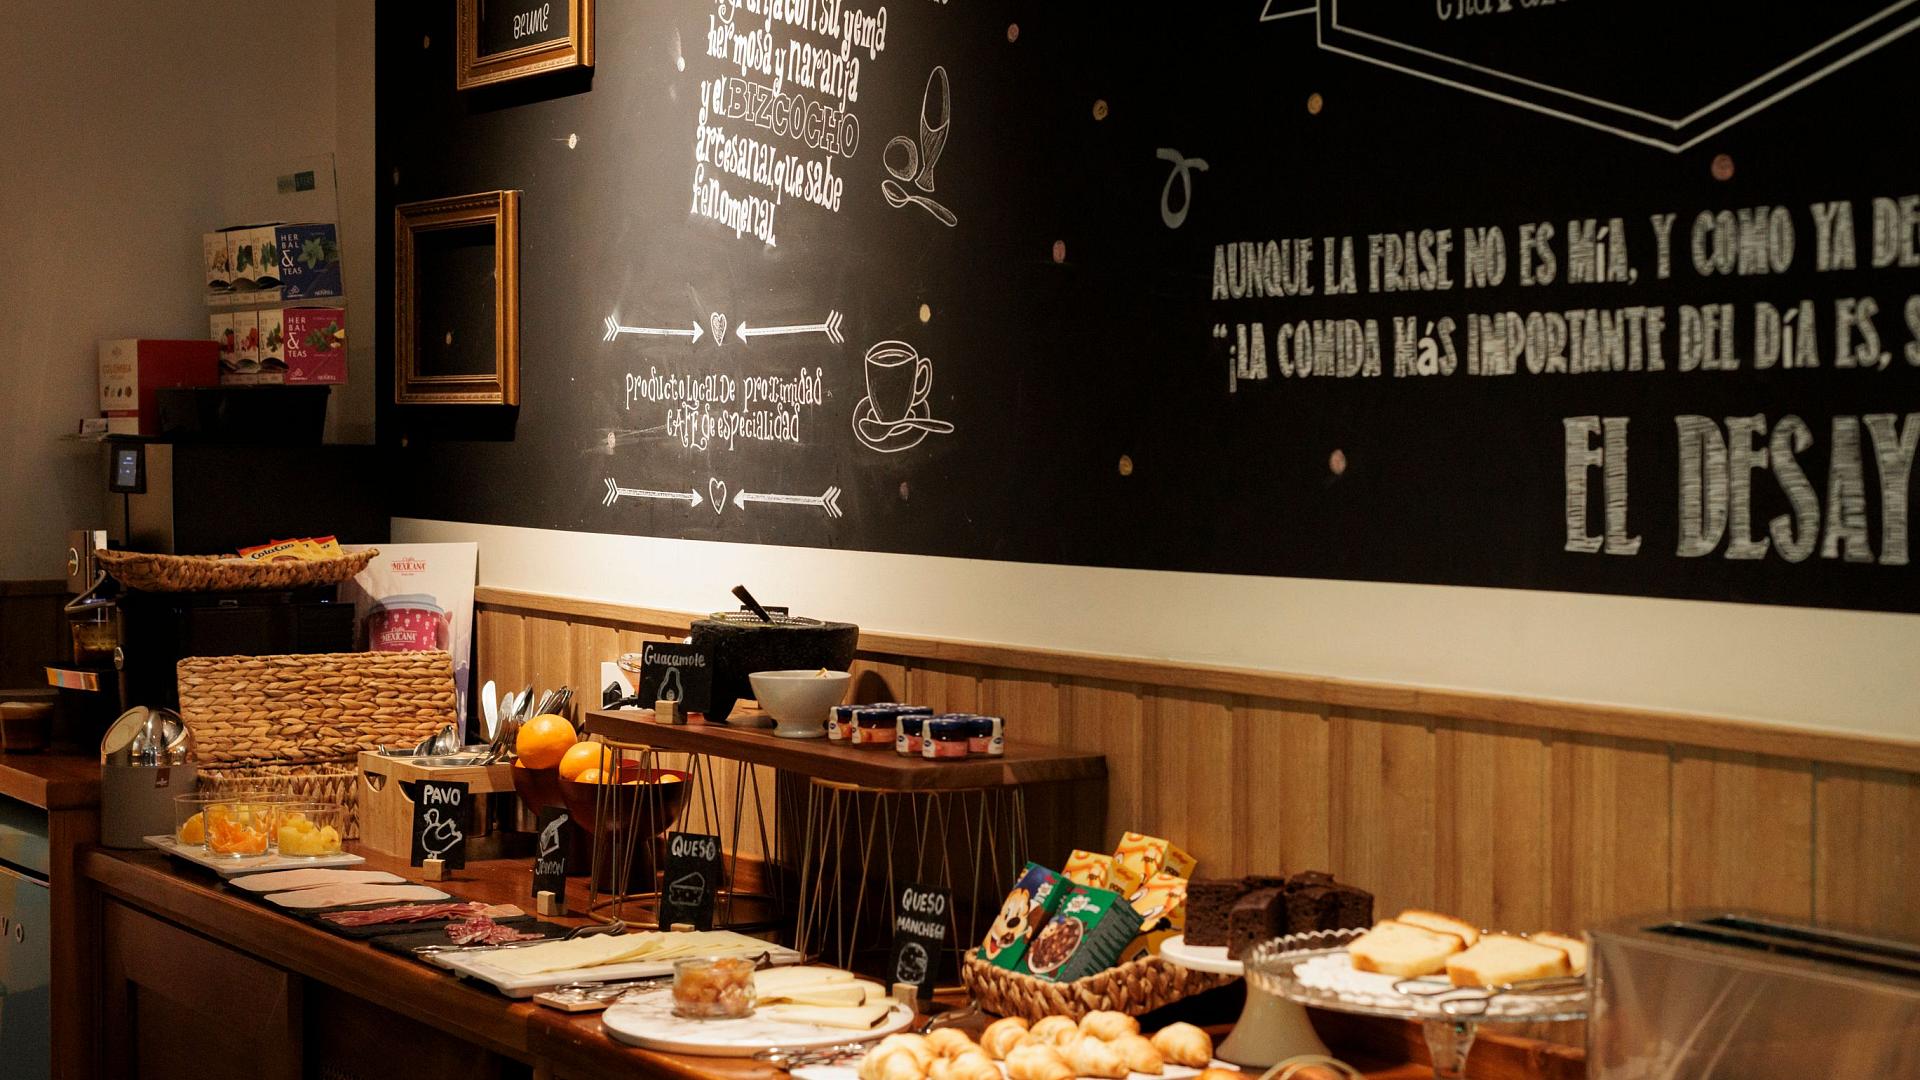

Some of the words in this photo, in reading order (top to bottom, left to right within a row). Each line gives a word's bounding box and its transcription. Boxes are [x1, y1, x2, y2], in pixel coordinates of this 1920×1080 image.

[842, 7, 888, 60] yema
[707, 15, 773, 76] hermosa
[773, 47, 787, 96] y
[788, 39, 861, 113] naranja
[699, 80, 713, 126] y
[728, 77, 860, 158] BIZCOCHO
[774, 155, 804, 205] que
[804, 156, 843, 213] sabe
[281, 233, 299, 242] HER
[281, 241, 300, 249] BAL
[281, 249, 295, 267] &
[1212, 237, 1315, 300] AUNQUE
[1323, 236, 1357, 296] LA
[1367, 228, 1454, 293] FRASE
[1464, 226, 1507, 288] NO
[1518, 221, 1557, 286] ES
[1650, 213, 1677, 279] Y
[1691, 205, 1795, 276] COMO
[1809, 200, 1857, 272] YA
[282, 267, 302, 276] TEAS
[287, 316, 306, 325] HER
[288, 324, 307, 332] BAL
[287, 332, 300, 350] &
[1277, 319, 1382, 378] COMIDA
[1467, 306, 1666, 376] IMPORTANTE
[1678, 303, 1740, 372] DEL
[1834, 296, 1893, 371] ES,
[287, 350, 308, 358] TEAS
[626, 366, 685, 410] Producto
[702, 403, 716, 441] de
[717, 402, 801, 451] especialidad
[1563, 415, 1642, 555] EL
[1674, 412, 1920, 566] DESAY
[251, 543, 295, 560] ColaCao
[391, 562, 426, 571] MEXICANA
[644, 644, 706, 667] Guacamole
[423, 784, 461, 806] PAVO
[902, 887, 945, 915] QUESO
